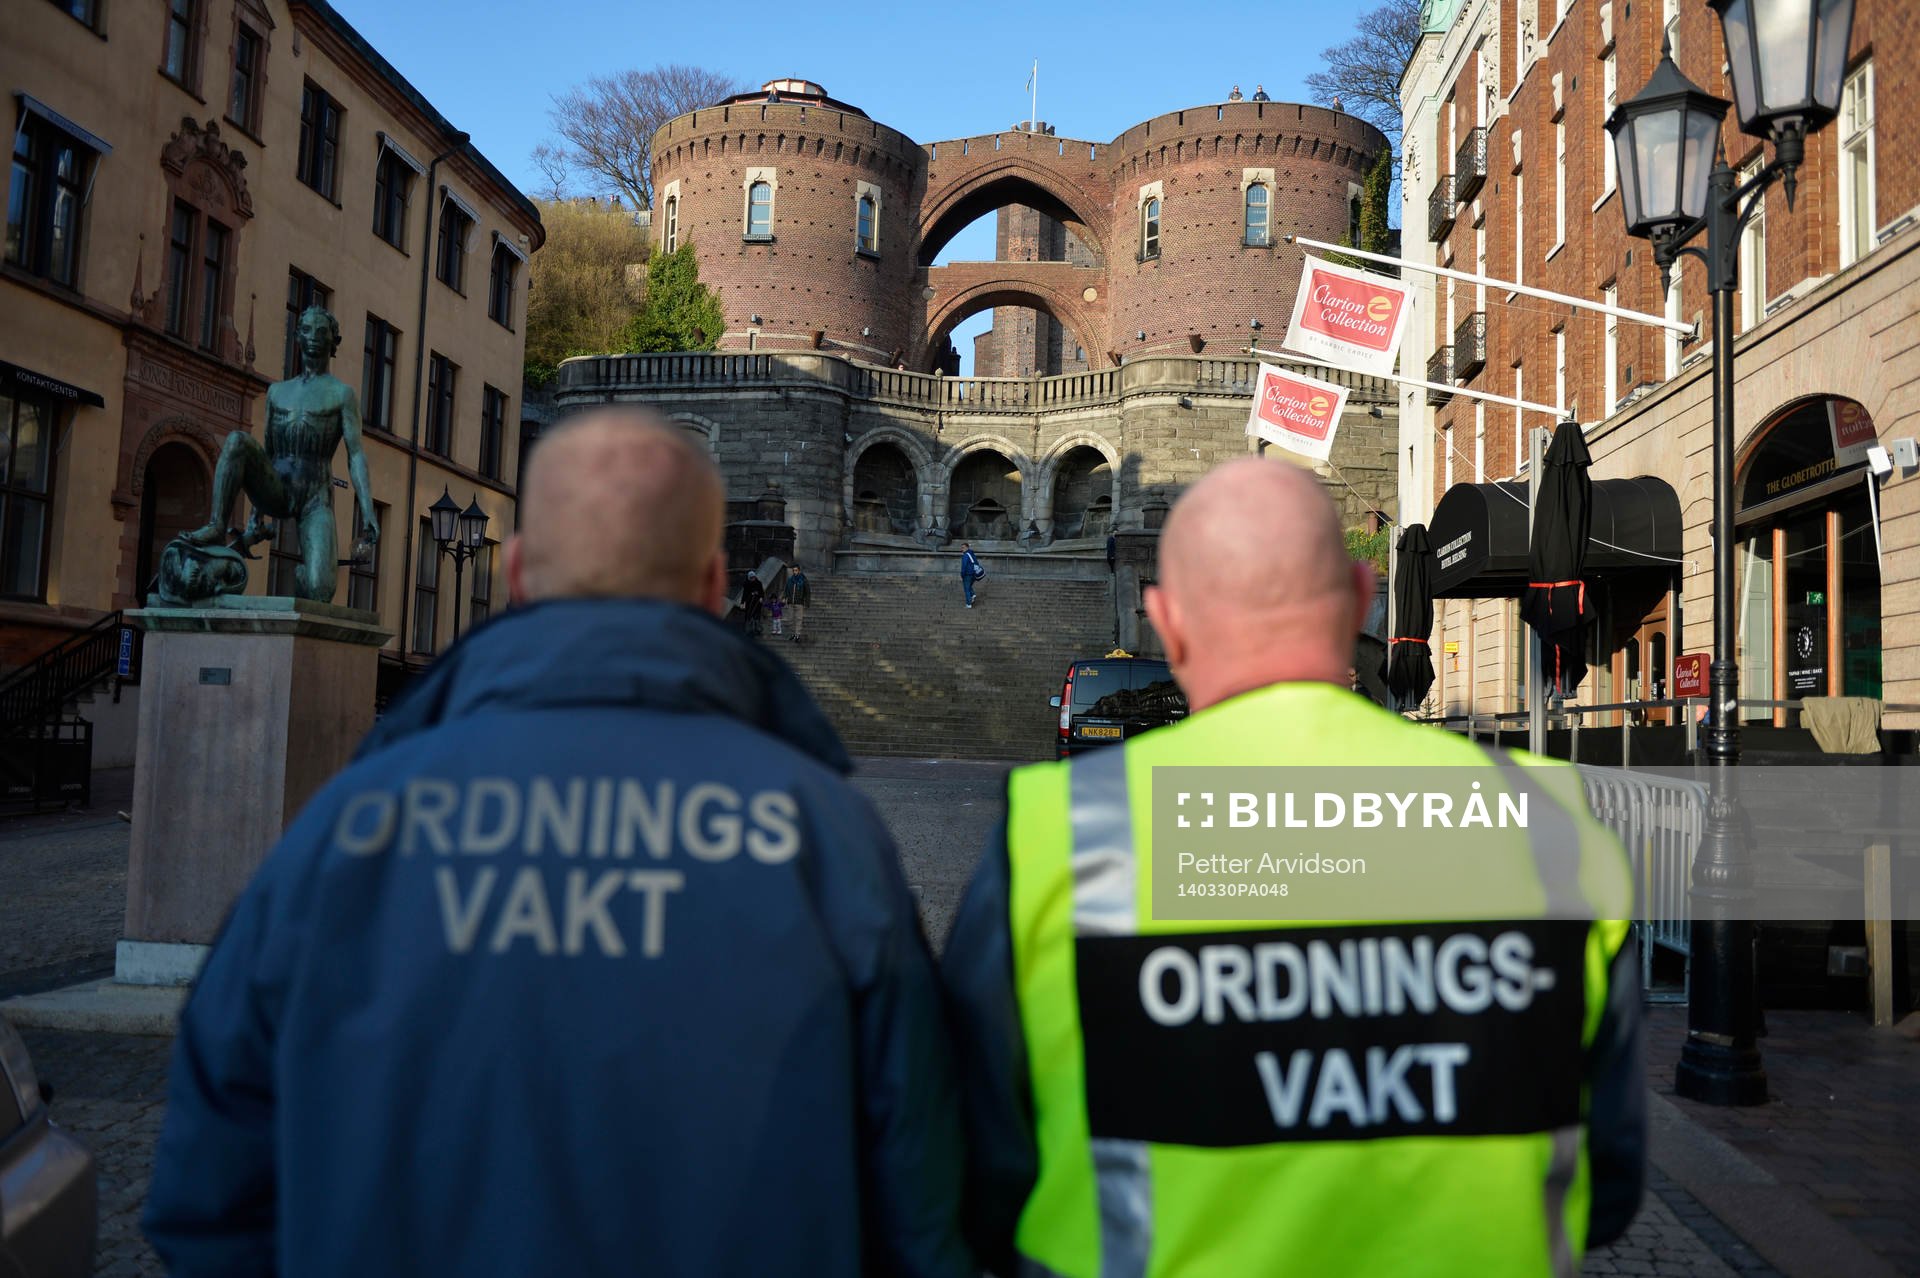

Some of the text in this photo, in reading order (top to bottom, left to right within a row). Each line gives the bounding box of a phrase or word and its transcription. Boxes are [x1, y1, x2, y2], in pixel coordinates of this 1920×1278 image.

[1313, 284, 1365, 315] Clarion
[1320, 308, 1387, 337] Collection
[16, 370, 78, 399] KONTAKTCENTER
[1266, 385, 1307, 411] Clarion
[1272, 403, 1325, 430] Collection
[1766, 454, 1840, 495] THE GLOBETROTTE
[124, 631, 130, 642] P
[1675, 664, 1692, 679] Clarion
[1680, 678, 1699, 688] Collection
[336, 777, 800, 864] ORDNINGS
[435, 865, 684, 957] VAKT
[1138, 931, 1556, 1027] ORDNINGS-
[1254, 1042, 1470, 1128] VAKT
